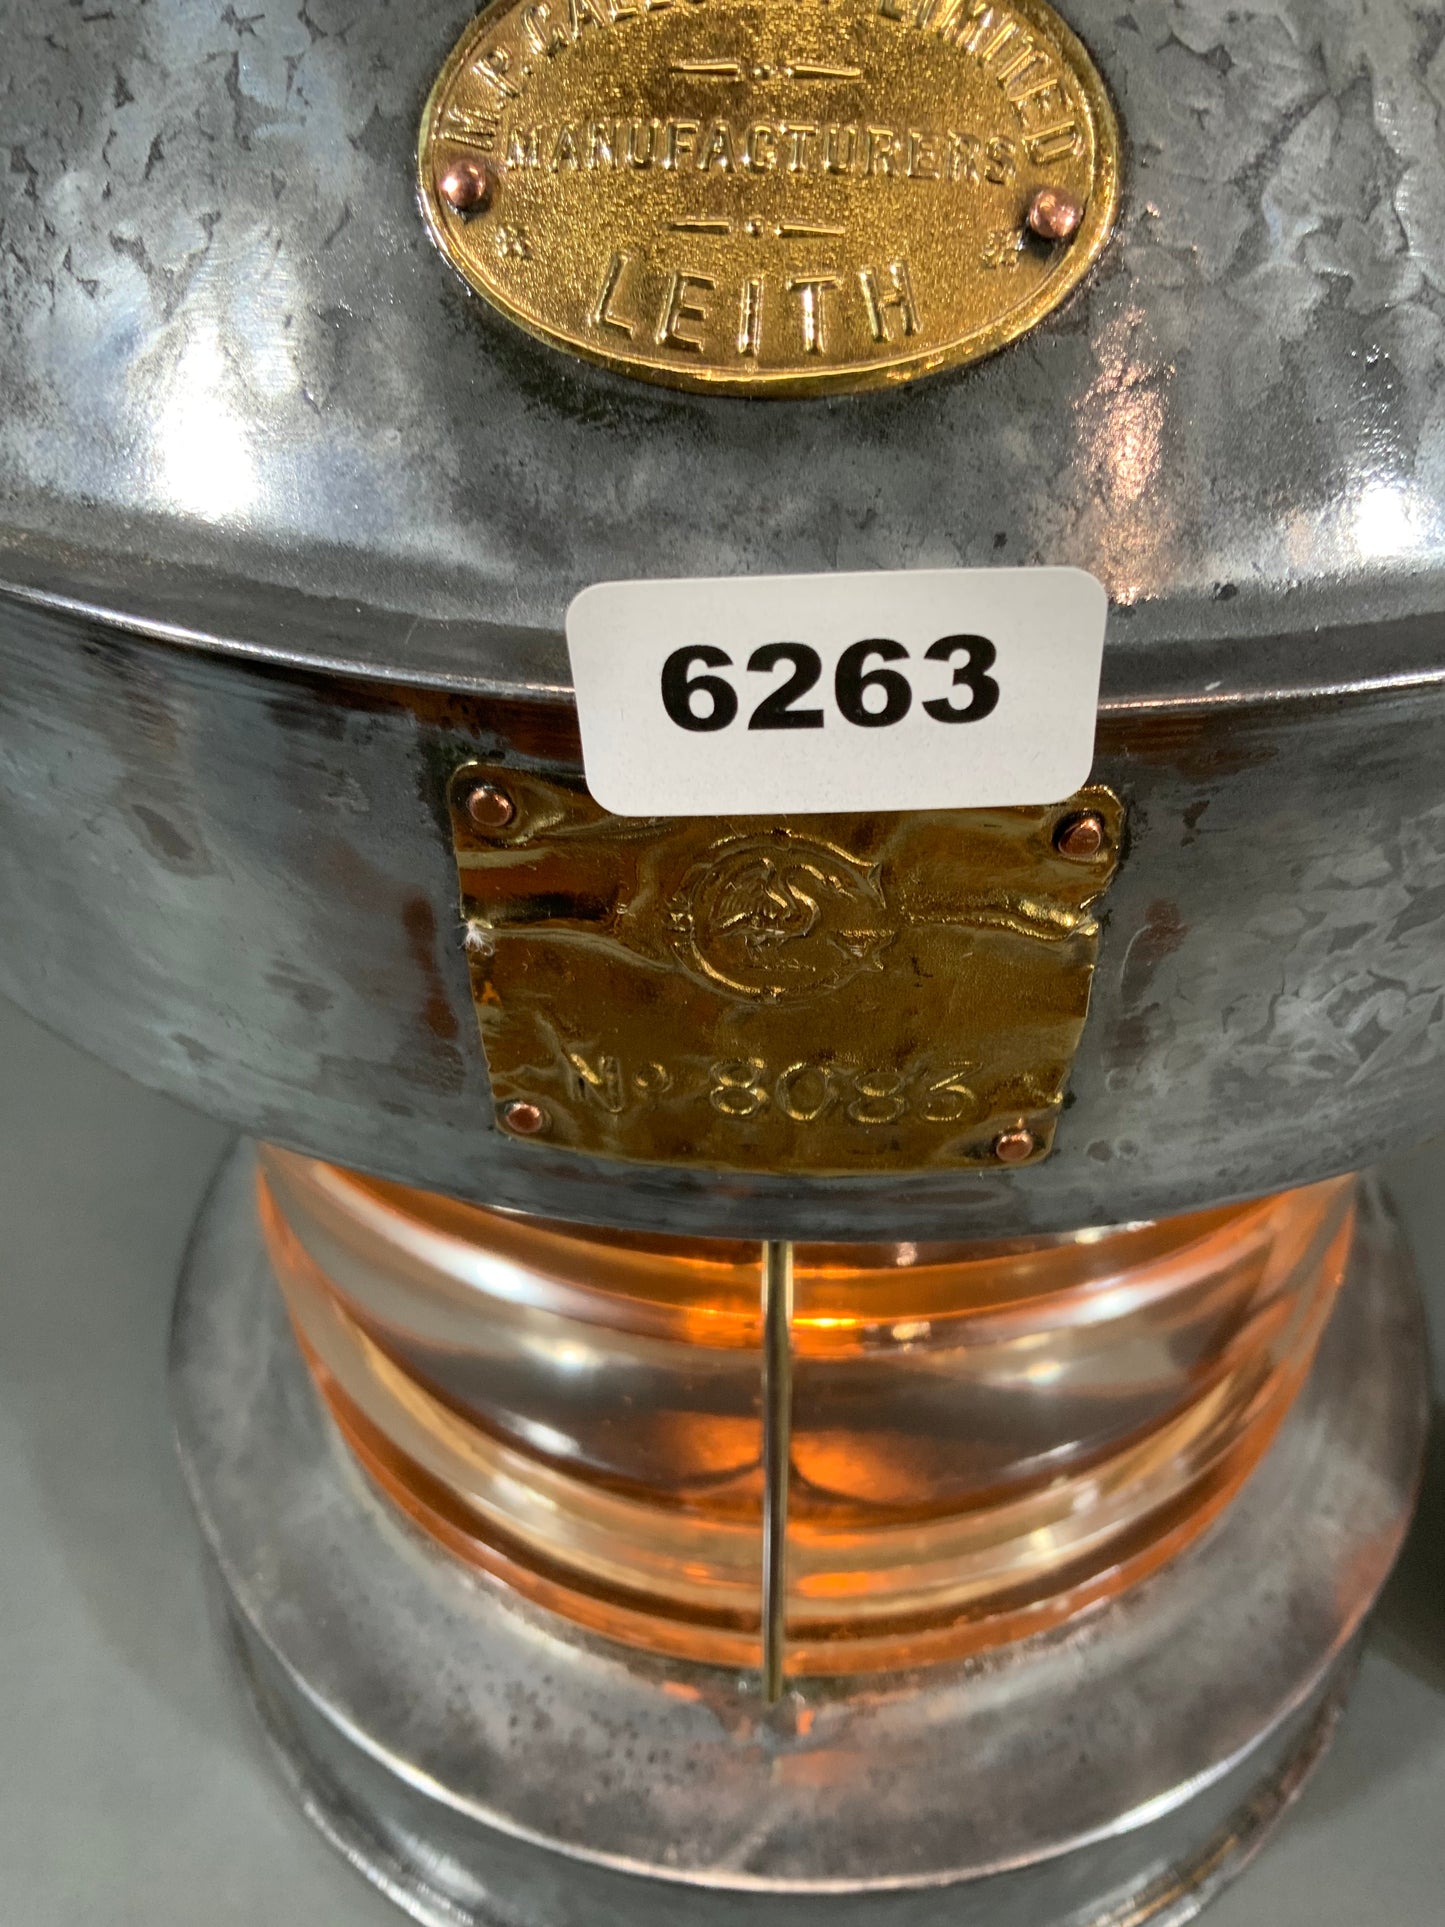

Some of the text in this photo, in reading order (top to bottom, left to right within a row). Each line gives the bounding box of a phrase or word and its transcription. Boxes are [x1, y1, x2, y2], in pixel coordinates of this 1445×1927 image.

[506, 118, 1016, 186] MANUFACTURERS
[588, 252, 922, 355] LEITH
[660, 634, 1000, 732] 6263
[709, 1057, 984, 1122] 8083
